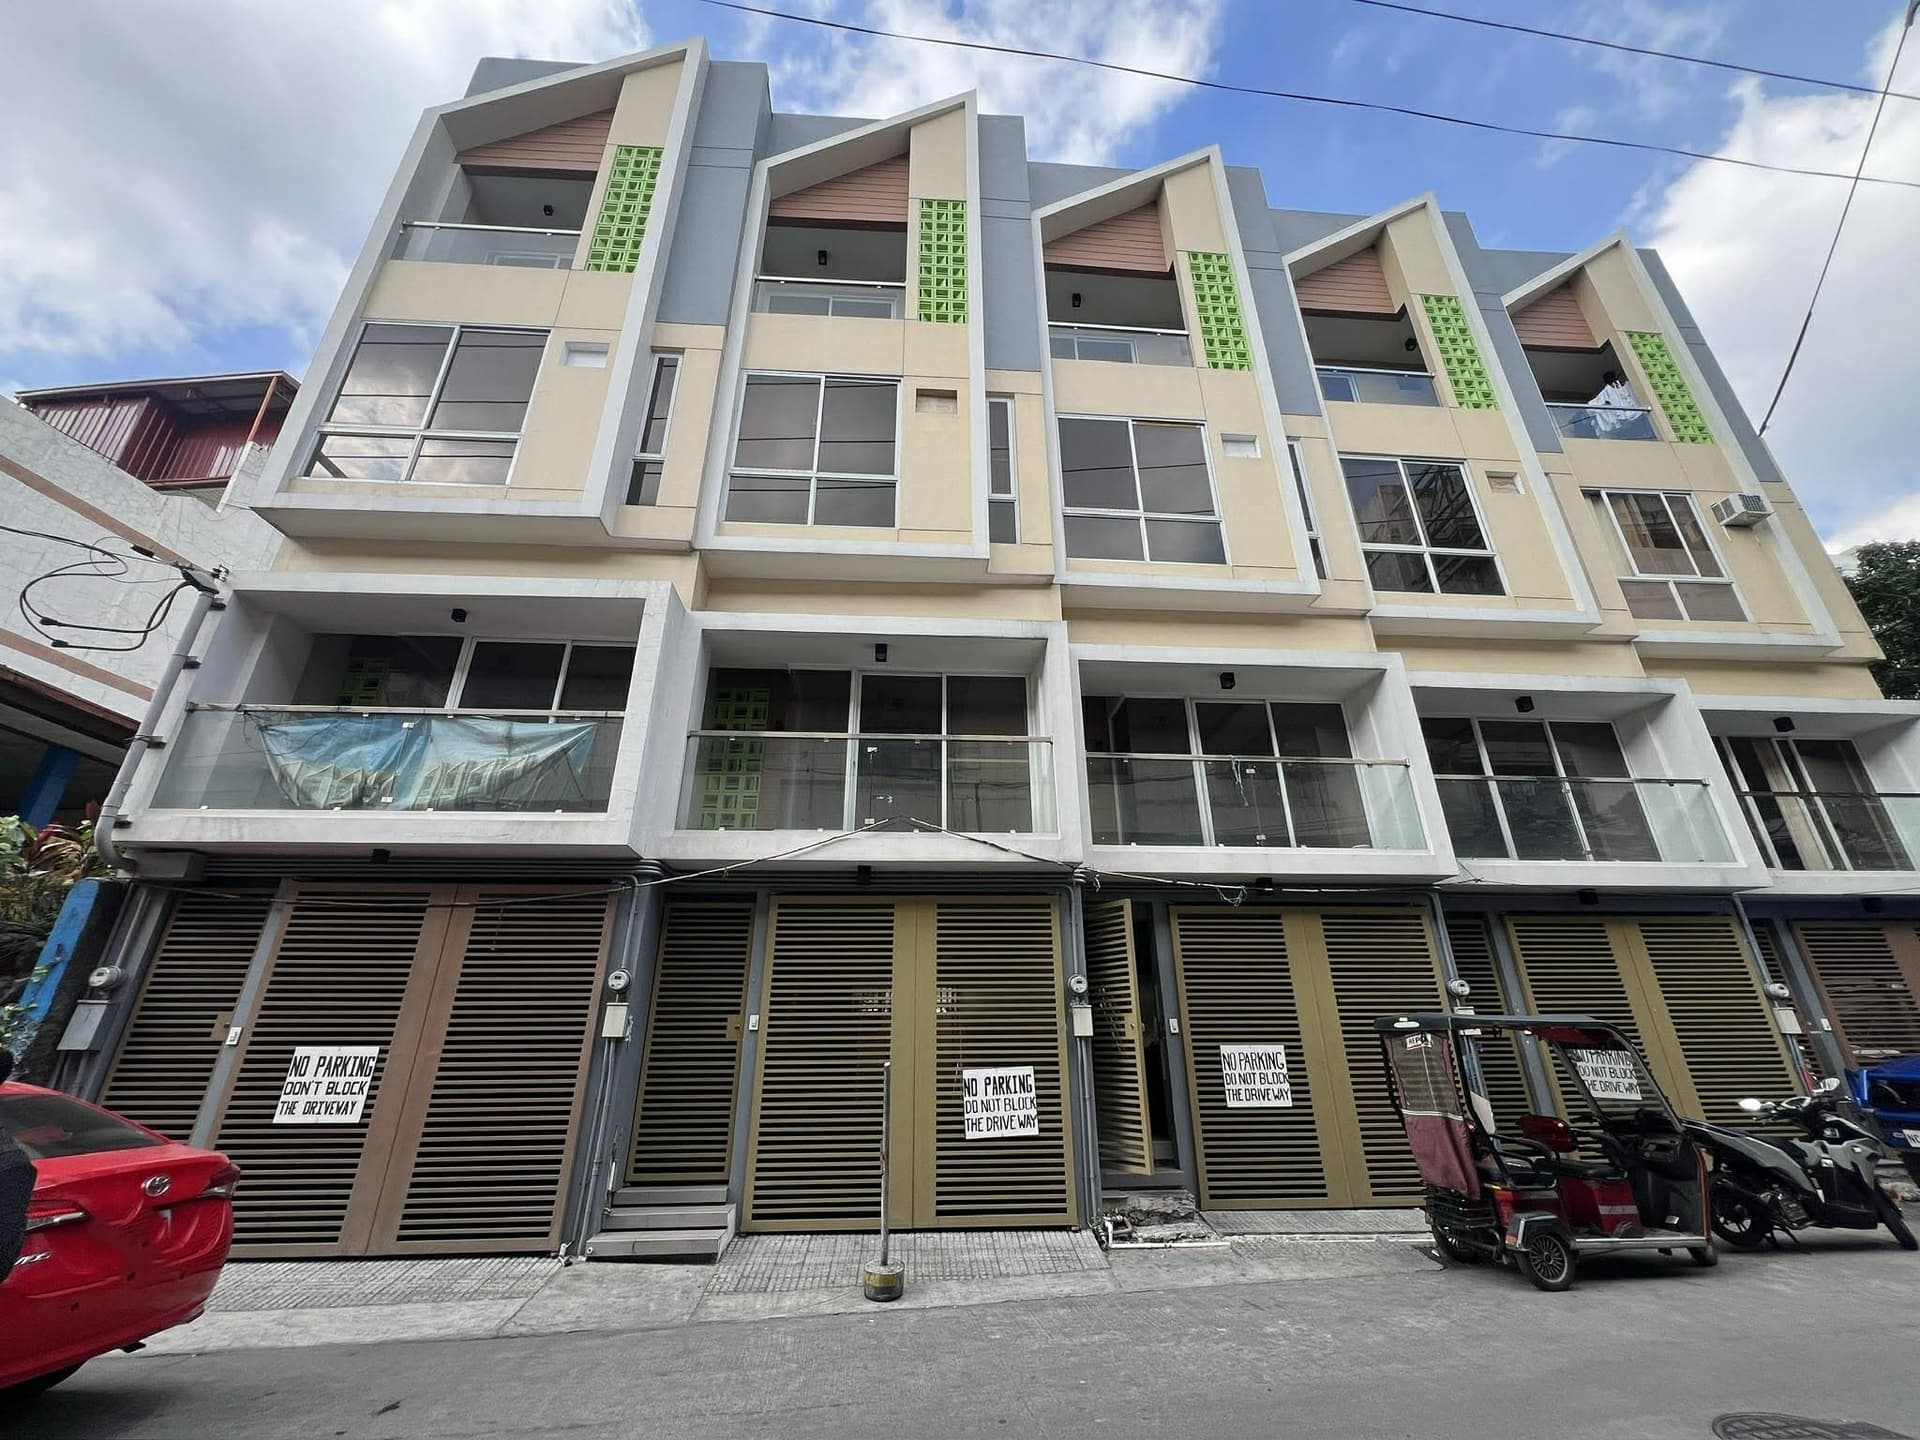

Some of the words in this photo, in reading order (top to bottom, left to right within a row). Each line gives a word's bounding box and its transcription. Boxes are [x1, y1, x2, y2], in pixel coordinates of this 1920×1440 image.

[289, 1055, 311, 1078] NO
[313, 1055, 376, 1078] PARKING
[1222, 1052, 1237, 1071] NO
[1239, 1051, 1285, 1071] PARKING
[1225, 1072, 1237, 1086] DO
[1239, 1072, 1256, 1086] NOT
[1258, 1072, 1291, 1085] BLOCK
[1578, 1065, 1591, 1077] DO
[1591, 1066, 1608, 1079] NOT
[283, 1080, 323, 1096] DON'T
[325, 1080, 369, 1096] BLOCK
[963, 1078, 978, 1097] NO
[984, 1074, 1033, 1097] PARKING
[1226, 1088, 1244, 1102] THE
[280, 1101, 299, 1115] THE
[303, 1101, 357, 1115] DRIVEWAY
[965, 1100, 978, 1114] DO
[981, 1099, 1001, 1113] NOT
[1003, 1097, 1037, 1112] BLOCK
[965, 1117, 984, 1132] THE
